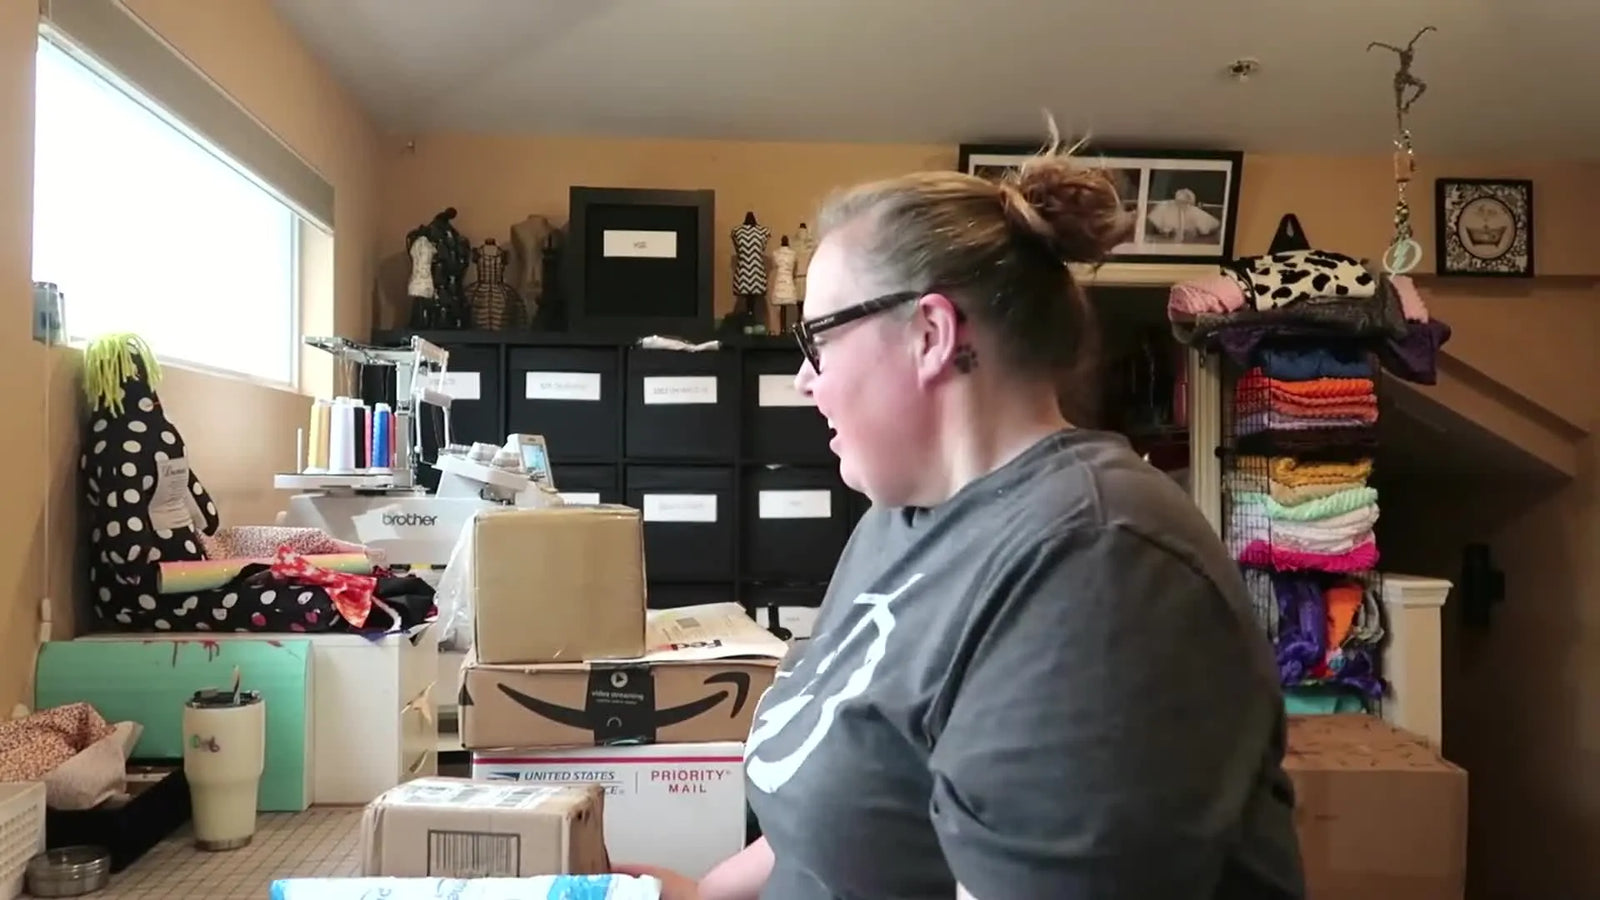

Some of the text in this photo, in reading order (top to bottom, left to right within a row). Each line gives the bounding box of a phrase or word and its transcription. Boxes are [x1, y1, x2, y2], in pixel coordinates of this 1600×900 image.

[382, 513, 438, 526] brother
[524, 771, 615, 781] UNITED STATES
[650, 769, 725, 781] PRIORITY
[668, 784, 707, 794] MAIL
